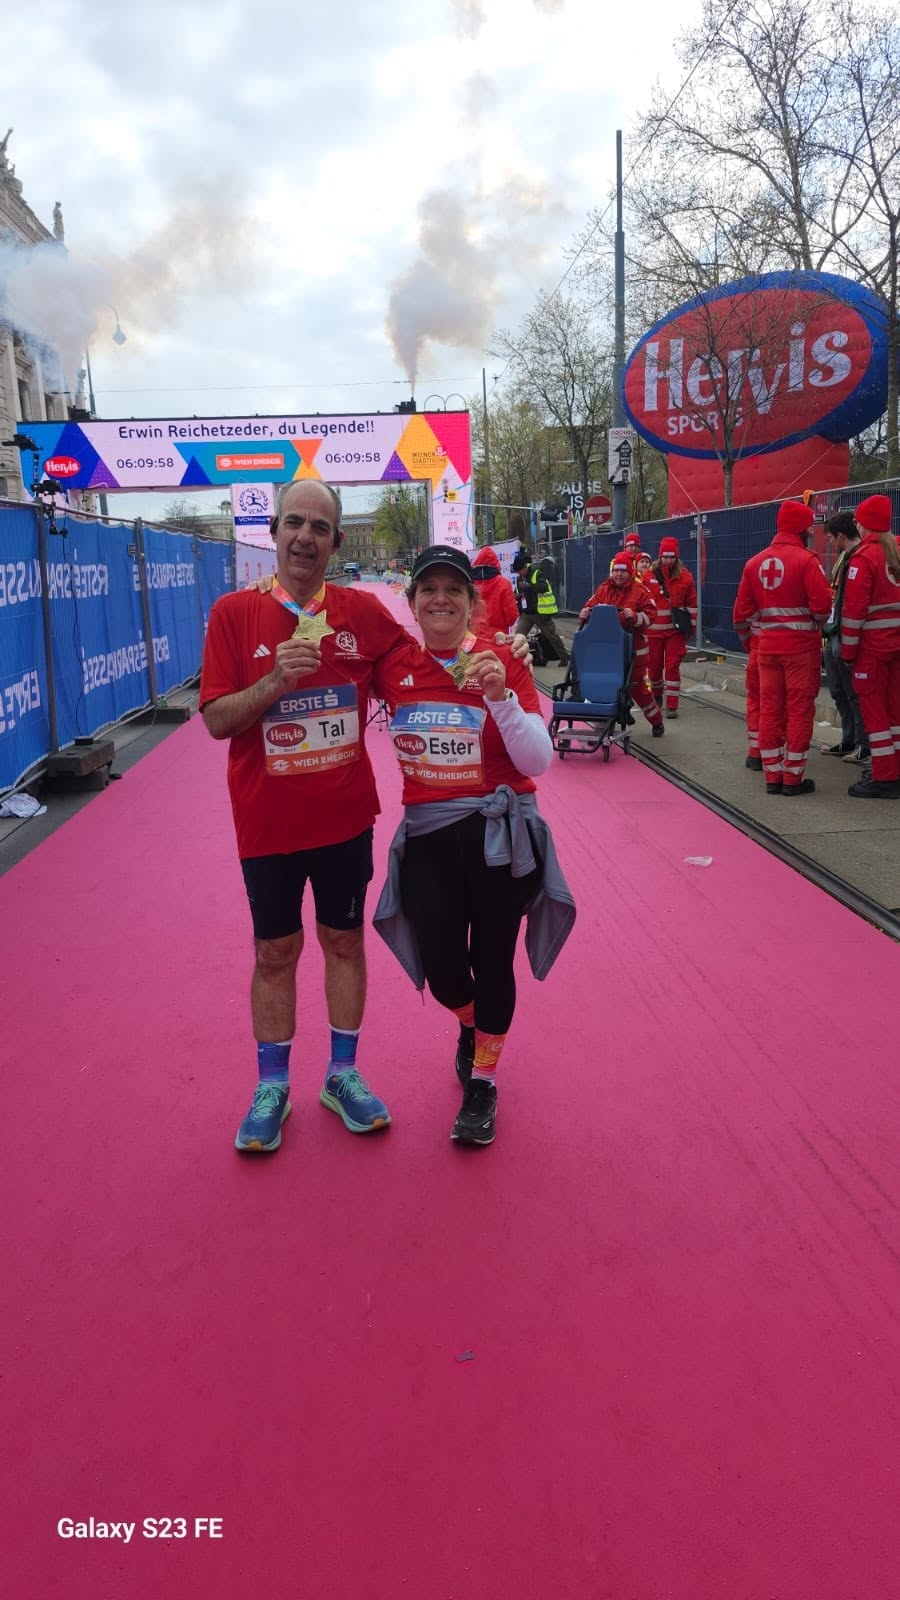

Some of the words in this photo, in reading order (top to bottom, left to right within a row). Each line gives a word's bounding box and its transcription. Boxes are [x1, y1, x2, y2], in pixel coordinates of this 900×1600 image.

[643, 322, 851, 415] Hervis
[118, 425, 163, 439] Erwin
[168, 421, 273, 438] Reichetzeder,
[278, 421, 297, 436] du
[302, 420, 375, 438] Legende!!
[46, 458, 79, 473] Hervis
[116, 457, 174, 469] 06:09:58
[325, 452, 381, 464] 06:09:58
[280, 695, 323, 713] ERSTE
[407, 711, 448, 724] ERSTE
[269, 728, 304, 742] Hervis
[318, 719, 345, 738] Tal
[396, 737, 425, 752] Hervis
[429, 737, 474, 755] Ester
[293, 756, 319, 768] WIEN
[321, 749, 356, 765] ENERGIE
[416, 769, 437, 779] WIEN
[438, 770, 479, 780] ENERGIE
